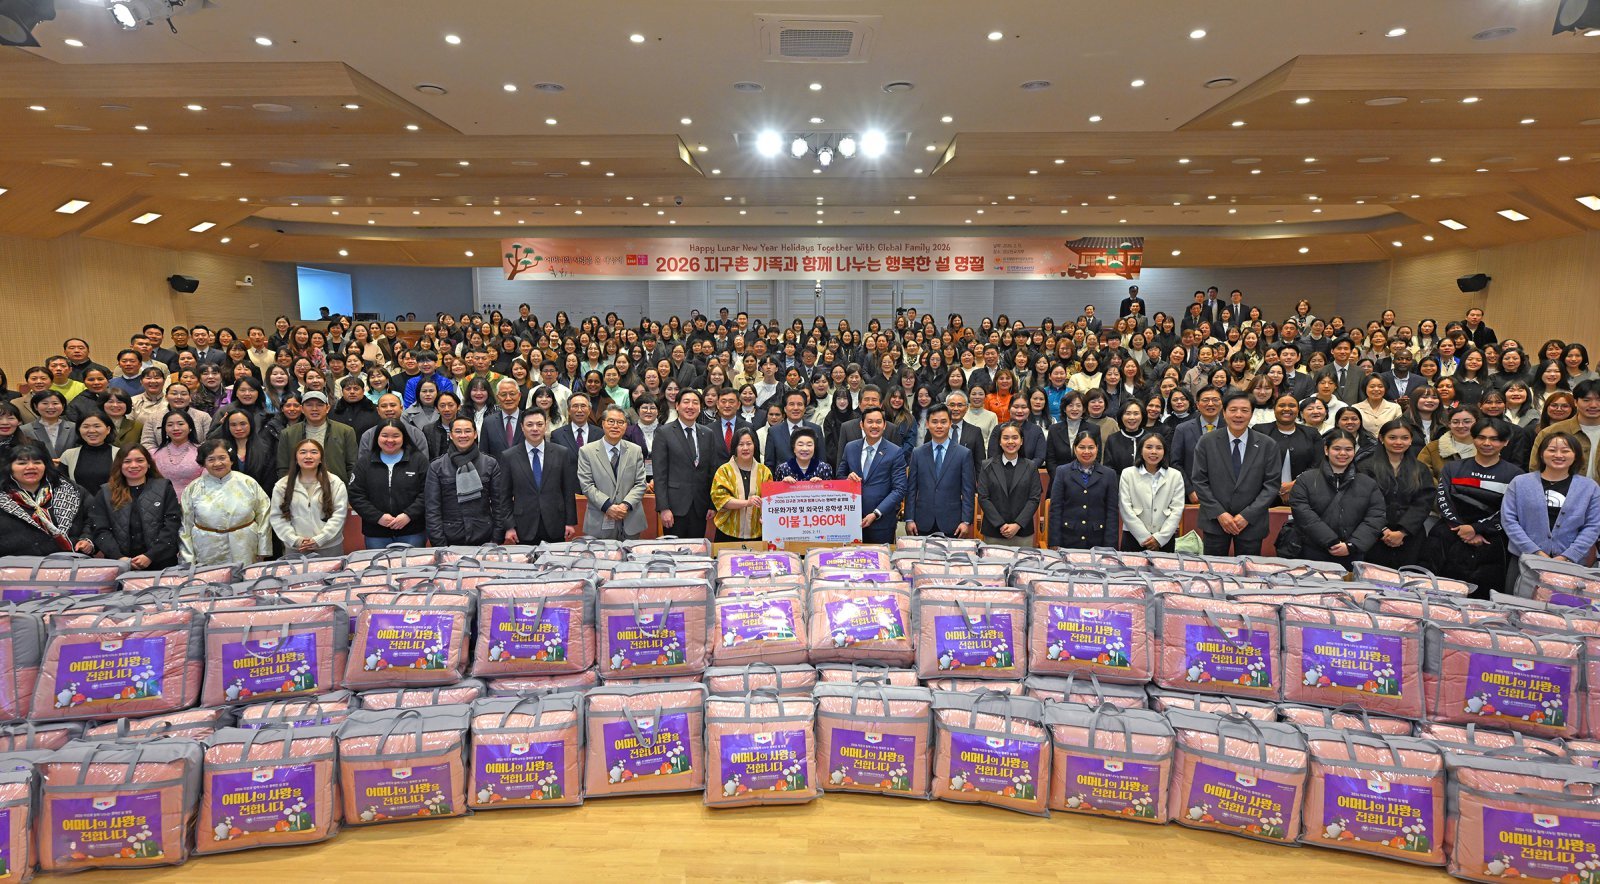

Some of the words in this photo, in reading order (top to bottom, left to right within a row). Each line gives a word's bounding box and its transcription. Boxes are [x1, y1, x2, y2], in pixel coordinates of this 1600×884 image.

[690, 244, 712, 254] Happy
[717, 244, 740, 252] Lunar
[744, 244, 760, 252] New
[762, 244, 778, 252] Year
[782, 244, 814, 254] Holidays
[818, 244, 853, 254] Together
[856, 243, 875, 252] With
[878, 243, 902, 252] Global
[905, 243, 930, 254] Family
[932, 244, 950, 252] 2026
[656, 256, 700, 272] 2026
[704, 256, 749, 272] 지구촌
[753, 256, 798, 272] 가족과
[802, 256, 832, 272] 함께
[836, 256, 880, 272] 나누는
[886, 256, 931, 272] 행복한
[935, 256, 950, 272] 설
[954, 256, 985, 272] 명절
[779, 516, 800, 528] 이불
[803, 514, 846, 528] 1,960채
[377, 630, 412, 640] 어머니의
[980, 630, 1004, 639] 사랑을
[1058, 622, 1092, 632] 어머니의
[1094, 626, 1120, 636] 사랑을
[388, 640, 425, 650] 전합니다
[630, 640, 663, 649] 전합니다
[958, 640, 992, 649] 전합니다
[1070, 635, 1106, 644] 전합니다
[1196, 642, 1233, 654] 어머니의
[1314, 645, 1356, 658] 어머니의
[1360, 650, 1390, 663] 사랑을
[69, 660, 114, 672] 어머니의
[118, 656, 151, 666] 사랑을
[233, 656, 273, 669] 어머니의
[276, 651, 305, 662] 사랑을
[1211, 654, 1248, 665] 전합니다
[1331, 658, 1374, 670] 전합니다
[85, 670, 132, 682] 전합니다
[249, 664, 290, 678] 전합니다
[1482, 672, 1526, 687] 어머니의
[1530, 680, 1560, 693] 사랑을
[1498, 686, 1543, 702] 전합니다
[630, 747, 667, 758] 전합니다
[731, 753, 767, 764] 어머니의
[770, 750, 796, 760] 사랑을
[840, 746, 876, 758] 어머니의
[878, 753, 904, 762] 사랑을
[854, 760, 890, 771] 전합니다
[960, 751, 998, 764] 어머니의
[1000, 756, 1028, 769] 사랑을
[485, 763, 522, 774] 어머니의
[526, 761, 553, 772] 사랑을
[746, 763, 783, 774] 전합니다
[975, 766, 1014, 778] 전합니다
[500, 773, 538, 784] 전합니다
[1077, 775, 1117, 788] 어머니의
[1120, 779, 1149, 792] 사랑을
[222, 792, 266, 805] 어머니의
[268, 787, 302, 799] 사랑을
[366, 786, 406, 797] 어머니의
[410, 783, 439, 793] 사랑을
[1092, 788, 1132, 800] 전합니다
[383, 795, 424, 805] 전합니다
[1204, 784, 1246, 803] 어머니의
[1250, 796, 1281, 812] 사랑을
[239, 802, 284, 816] 전합니다
[1218, 800, 1263, 818] 전합니다
[1337, 796, 1384, 812] 어머니의
[1387, 803, 1421, 817] 사랑을
[62, 817, 108, 830] 어머니의
[111, 816, 146, 826] 사랑을
[1355, 812, 1404, 828] 전합니다
[81, 830, 127, 841] 전합니다
[1500, 831, 1553, 848] 어머니의
[1556, 838, 1596, 852] 사랑을
[1521, 847, 1576, 863] 전합니다
